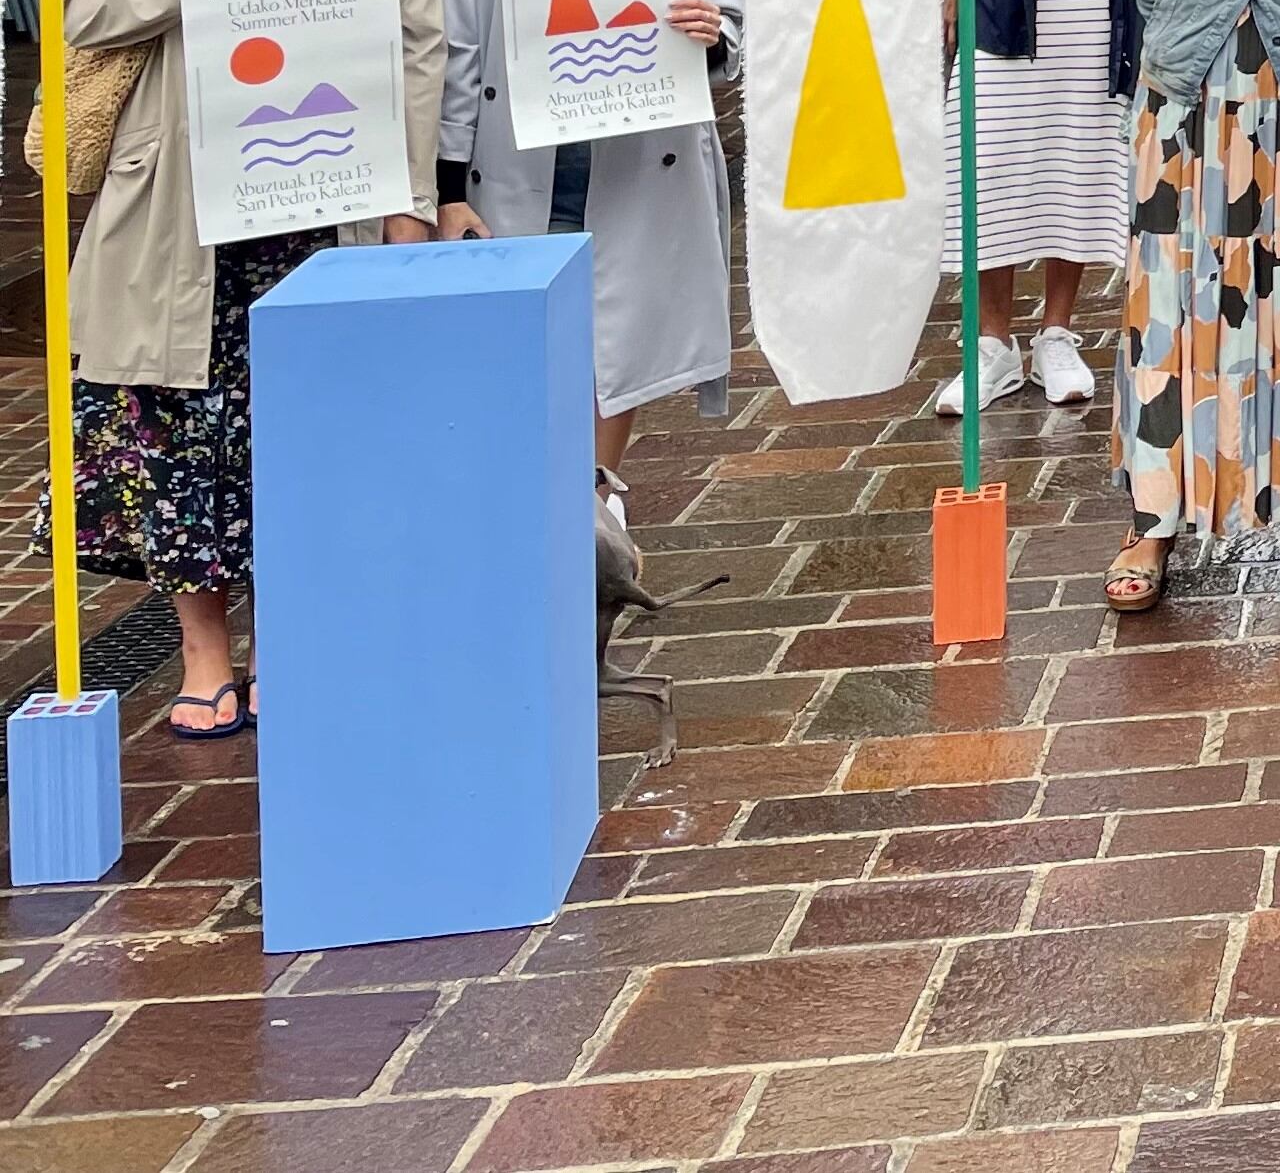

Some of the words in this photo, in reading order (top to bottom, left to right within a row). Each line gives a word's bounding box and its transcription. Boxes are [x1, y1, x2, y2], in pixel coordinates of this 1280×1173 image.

[228, 0, 280, 17] Udako
[231, 15, 298, 33] Summer
[301, 6, 354, 25] Market
[546, 85, 614, 108] Abuztuak
[617, 83, 633, 97] 12
[635, 81, 656, 94] eta
[550, 108, 578, 121] San
[581, 101, 624, 117] Pedro
[628, 94, 675, 111] Kalean
[233, 173, 307, 199] Abuztuak
[309, 170, 326, 186] 12
[328, 170, 353, 183] eta
[236, 198, 266, 214] San
[269, 190, 316, 209] Pedro
[320, 182, 372, 201] Kalean
